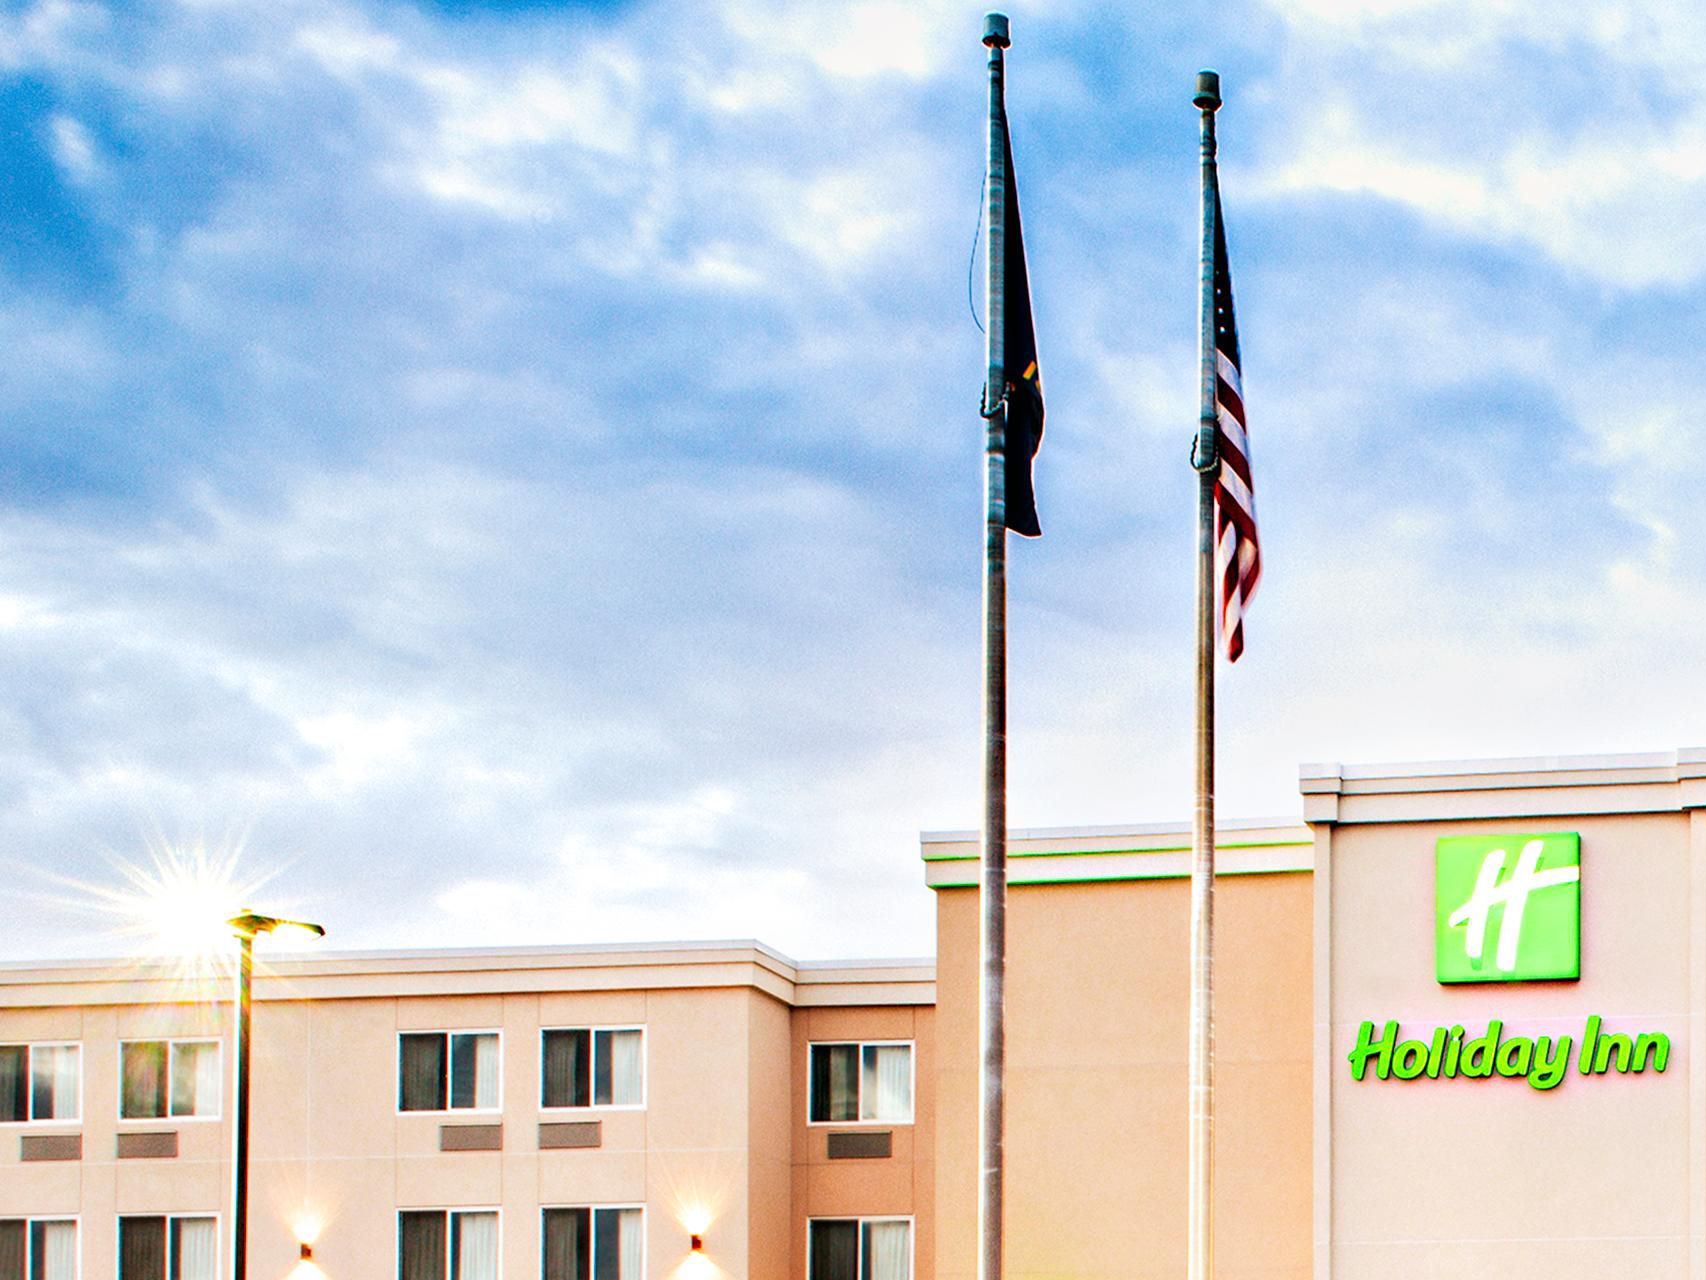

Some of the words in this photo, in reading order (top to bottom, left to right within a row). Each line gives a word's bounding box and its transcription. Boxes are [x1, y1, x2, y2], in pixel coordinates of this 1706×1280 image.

[1448, 840, 1580, 972] H
[1347, 1019, 1572, 1091] Holiday
[1579, 1014, 1671, 1075] Inn
